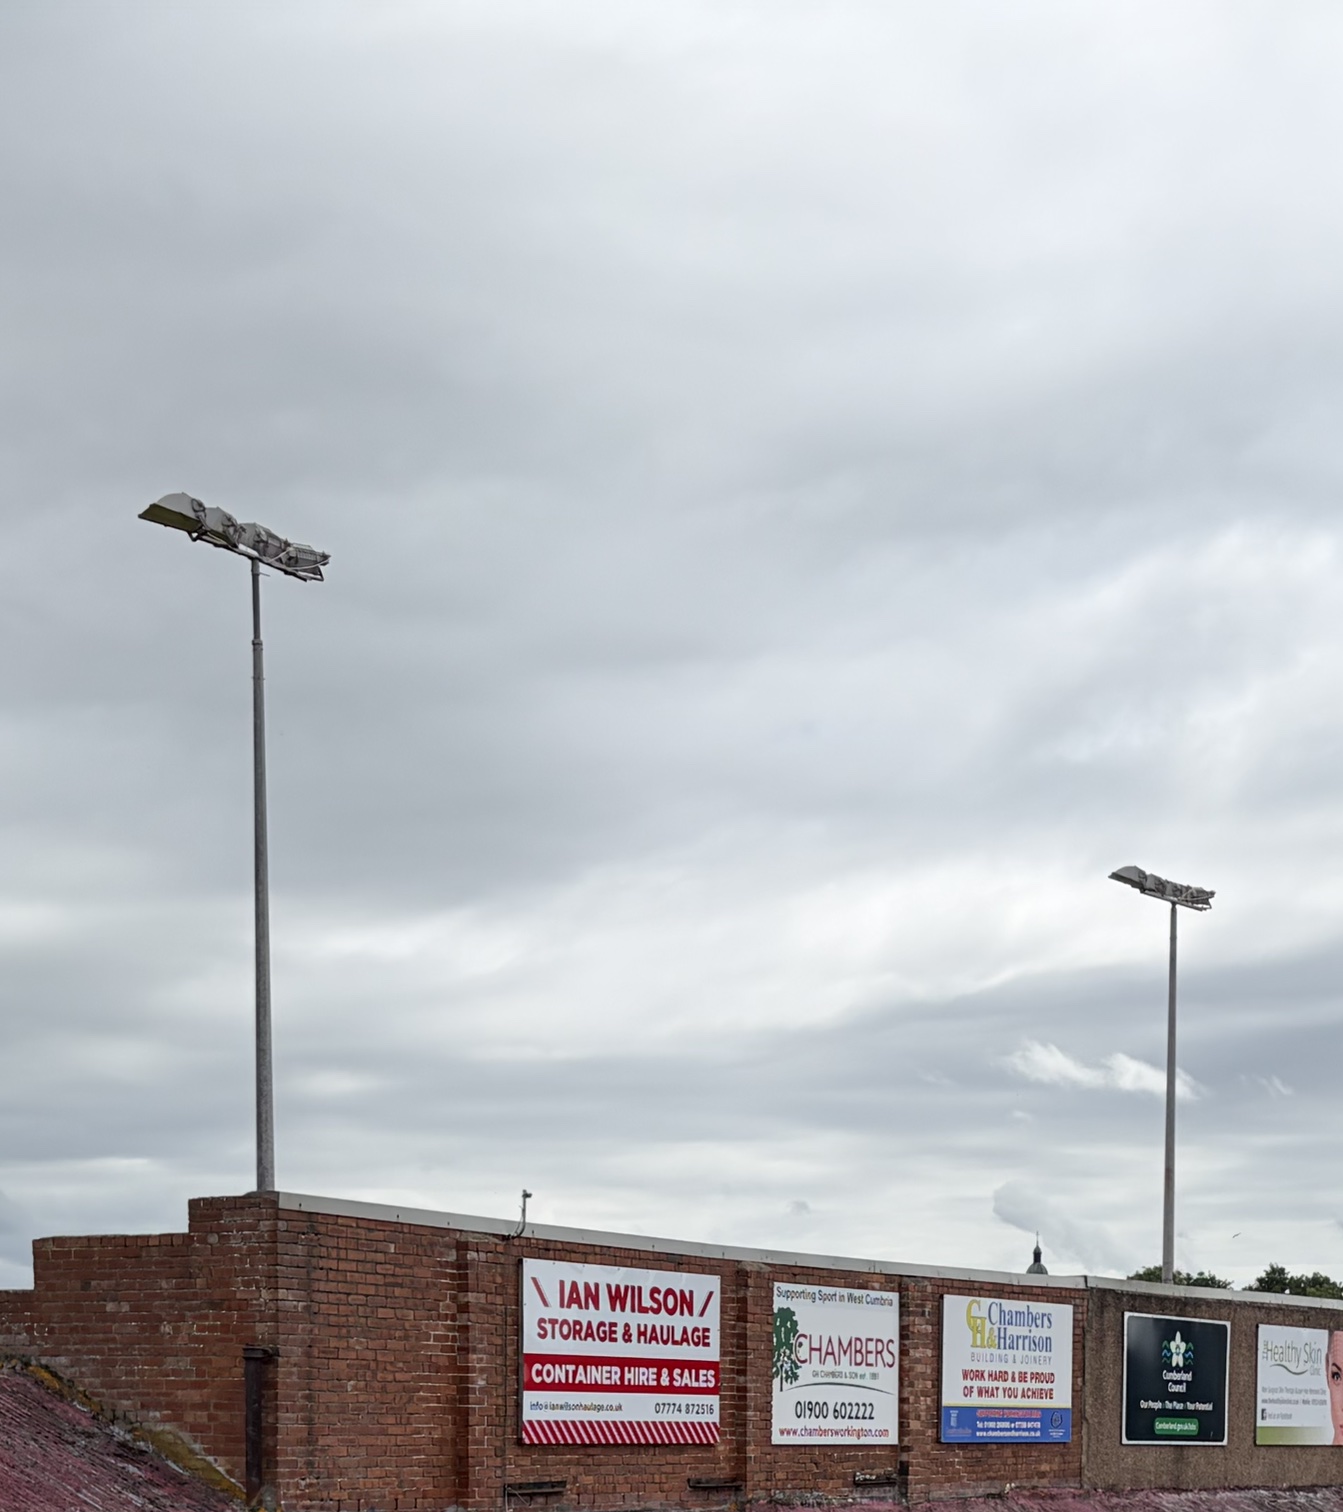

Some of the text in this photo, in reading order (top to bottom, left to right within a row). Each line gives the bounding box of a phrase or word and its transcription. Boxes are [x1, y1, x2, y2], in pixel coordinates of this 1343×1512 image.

[559, 1280, 694, 1317] IAN WILSON
[776, 1286, 893, 1307] Supporting Sport in West Cumbria
[988, 1301, 1052, 1329] Chambers
[537, 1318, 711, 1348] STORAGE & HAULAGE
[997, 1327, 1052, 1353] Harrison
[795, 1333, 895, 1368] CHAMBERS
[971, 1352, 1052, 1366] BUILDING & JOINERY
[1266, 1340, 1322, 1369] Healthy Skin
[531, 1363, 715, 1388] CONTAINER HIRE & SALES
[962, 1369, 1055, 1384] WORK HARD & BE PROUD
[1162, 1370, 1193, 1381] Cumberland
[963, 1386, 1054, 1400] OF WHAT YOU ACHIEVE
[1168, 1382, 1187, 1393] Council
[530, 1401, 715, 1415] info@ianwilsonhaulage.co.uk 07774 872516
[795, 1400, 875, 1420] 01900 602222
[779, 1425, 889, 1440] www.chambersworkington.com
